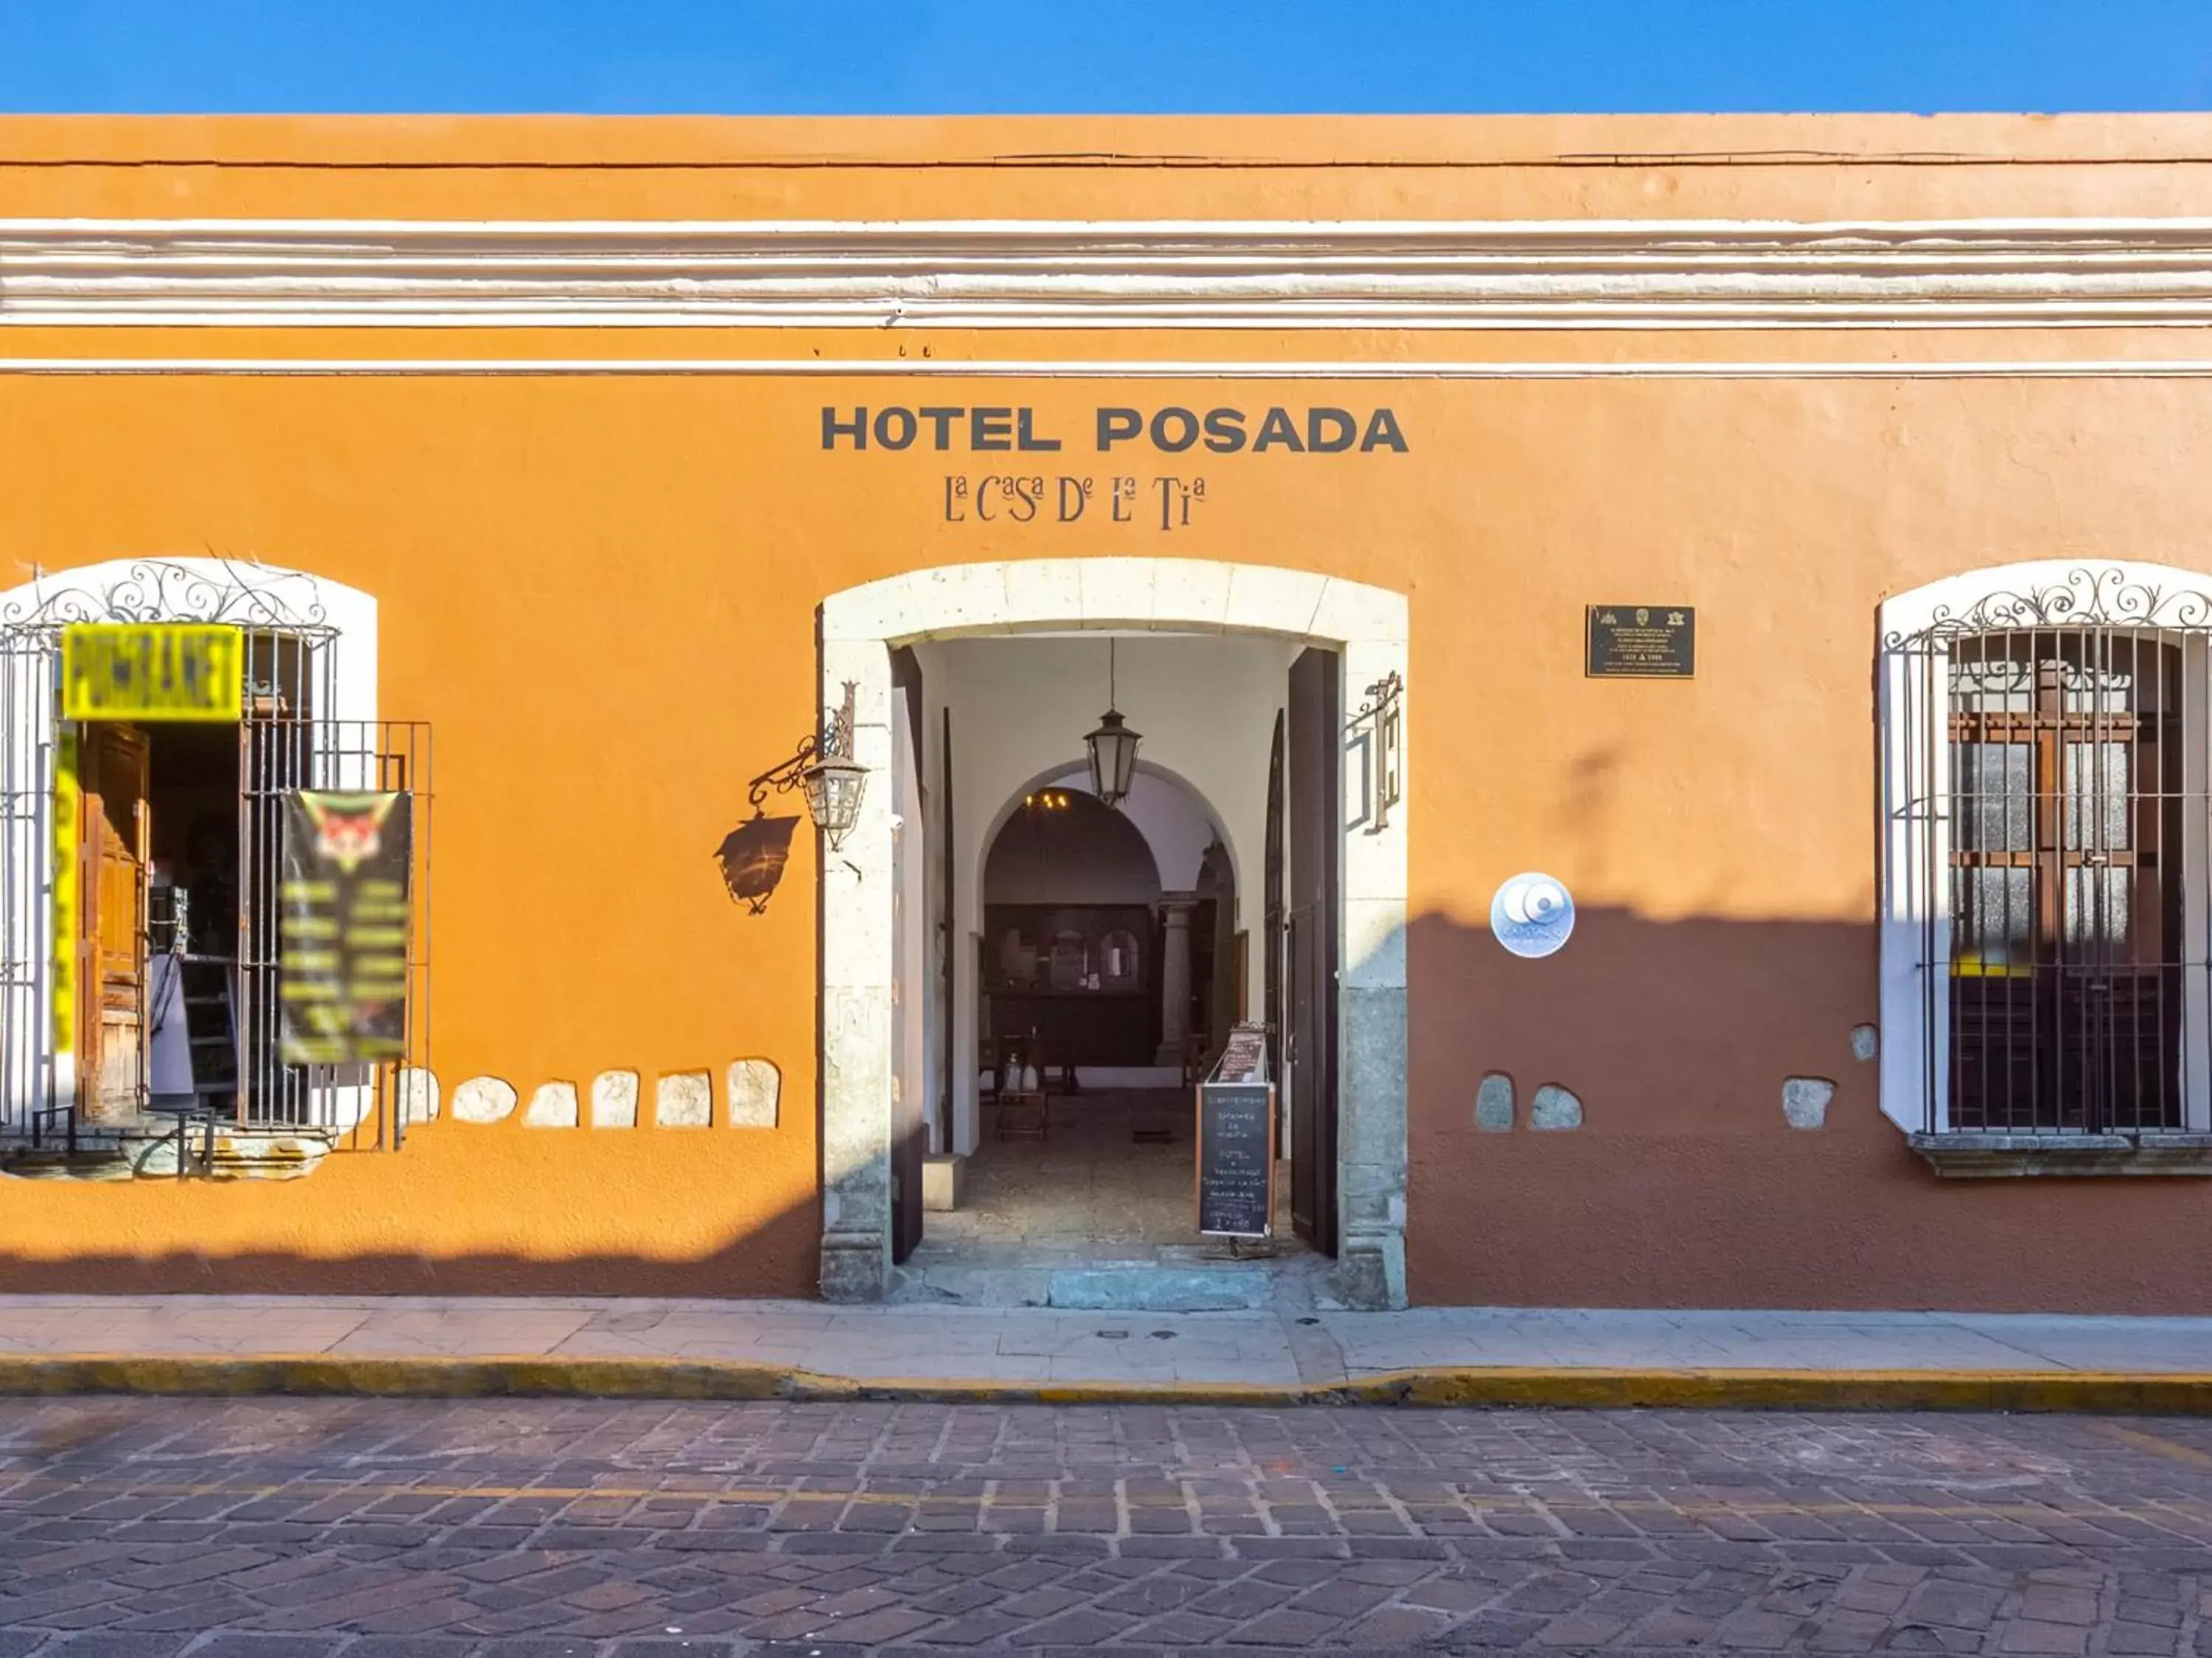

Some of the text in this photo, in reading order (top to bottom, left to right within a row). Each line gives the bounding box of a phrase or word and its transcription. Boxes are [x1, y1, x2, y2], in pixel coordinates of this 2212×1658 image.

[821, 406, 1410, 454] HOTEL POSADA
[945, 475, 968, 522] La
[1057, 476, 1093, 522] De
[1112, 476, 1136, 522] La
[1152, 476, 1206, 531] Tia
